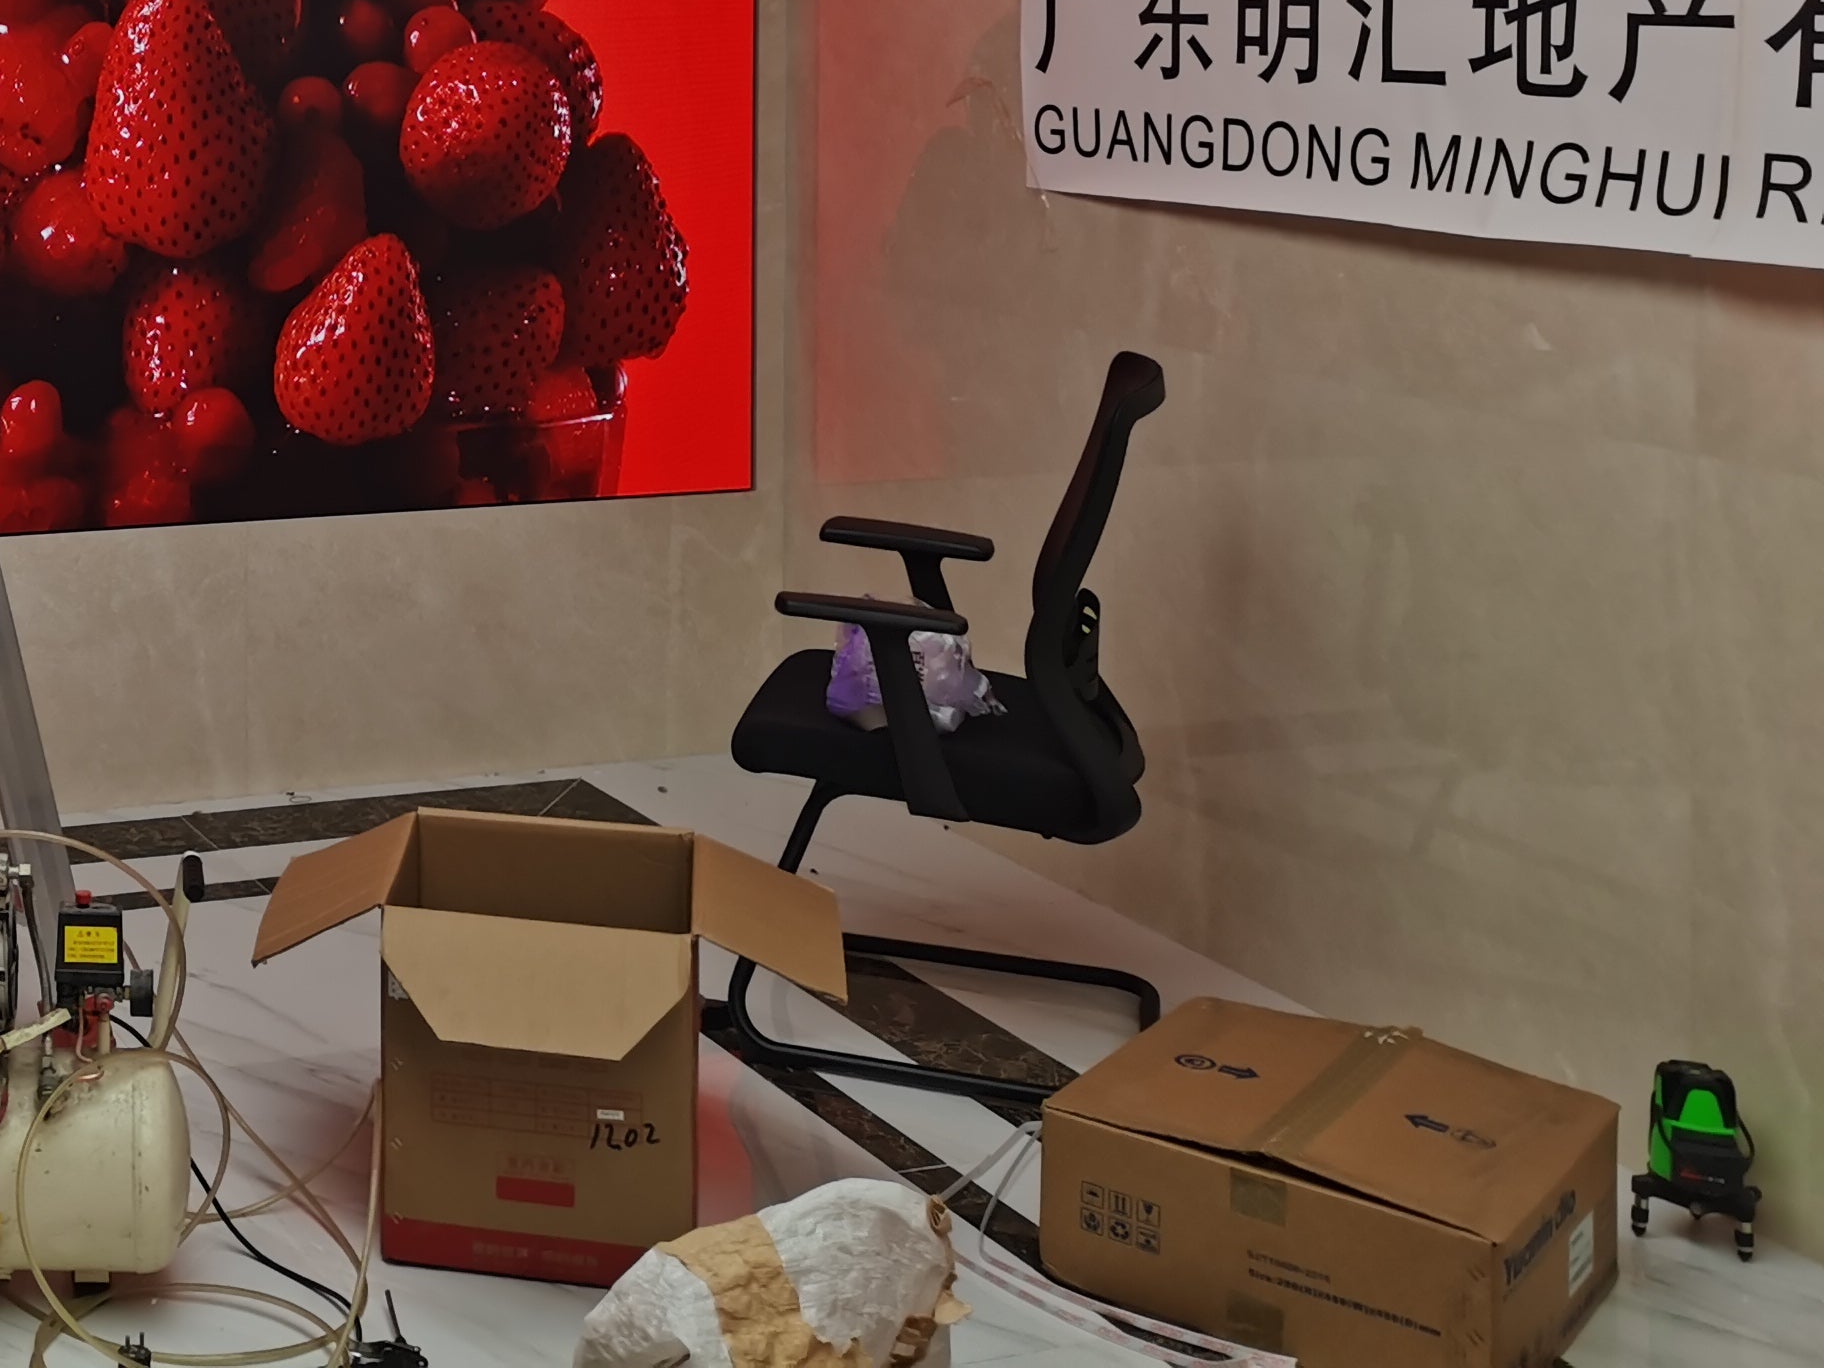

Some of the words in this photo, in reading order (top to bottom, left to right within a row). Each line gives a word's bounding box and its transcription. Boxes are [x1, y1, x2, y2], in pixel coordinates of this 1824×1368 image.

[1033, 104, 1391, 187] GUANGDONG
[1409, 132, 1731, 221] MINGHUI
[1755, 152, 1824, 226] R
[590, 1123, 661, 1151] 1202
